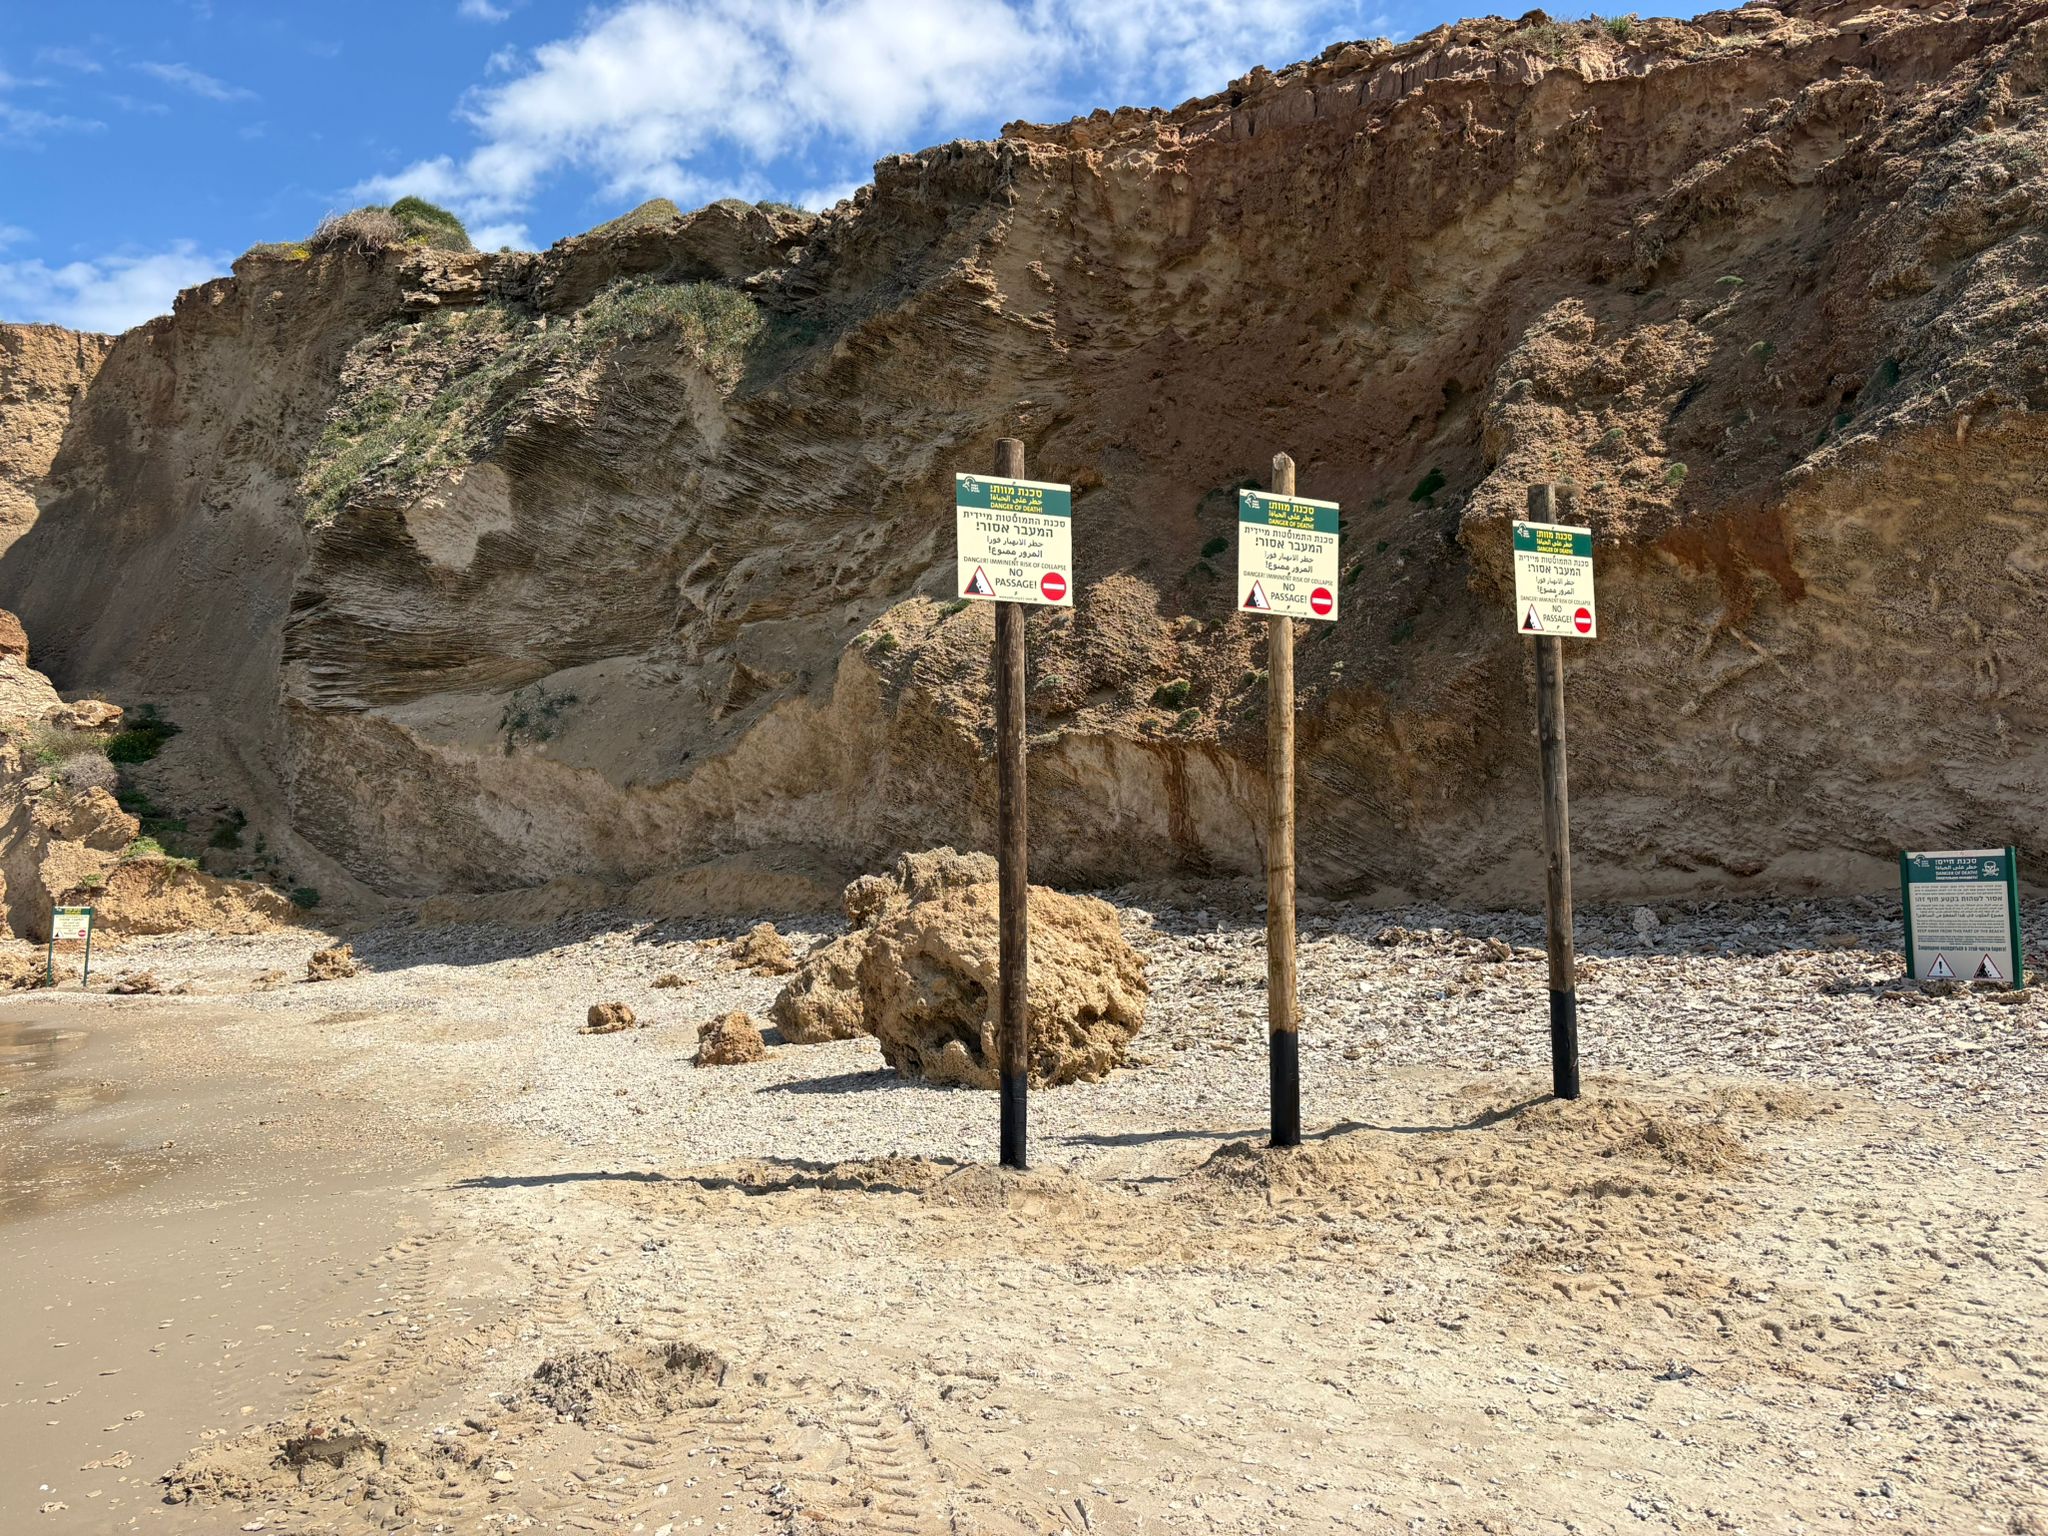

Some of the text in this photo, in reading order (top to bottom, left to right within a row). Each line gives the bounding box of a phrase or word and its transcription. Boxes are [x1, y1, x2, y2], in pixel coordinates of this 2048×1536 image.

[990, 485, 1014, 495] מוות!
[1018, 488, 1042, 498] סכנת
[1269, 502, 1290, 511] מוות!
[1293, 505, 1314, 514] סכנת
[963, 511, 1065, 527] סכנת התמוטטות מיידית
[976, 521, 1053, 537] המעבר אסור!
[1244, 526, 1270, 535] מיידית
[1273, 530, 1312, 541] התמוטטות
[1555, 533, 1572, 541] סכנת
[1256, 537, 1322, 553] המעבר אסור!
[988, 546, 1042, 558] المرور ممنوع!
[1009, 568, 1023, 577] NO
[1528, 564, 1581, 576] המעבר אסור!
[996, 578, 1036, 589] PASSAGE!
[1271, 592, 1307, 603] PASSAGE!
[1543, 614, 1572, 623] PASSAGE!
